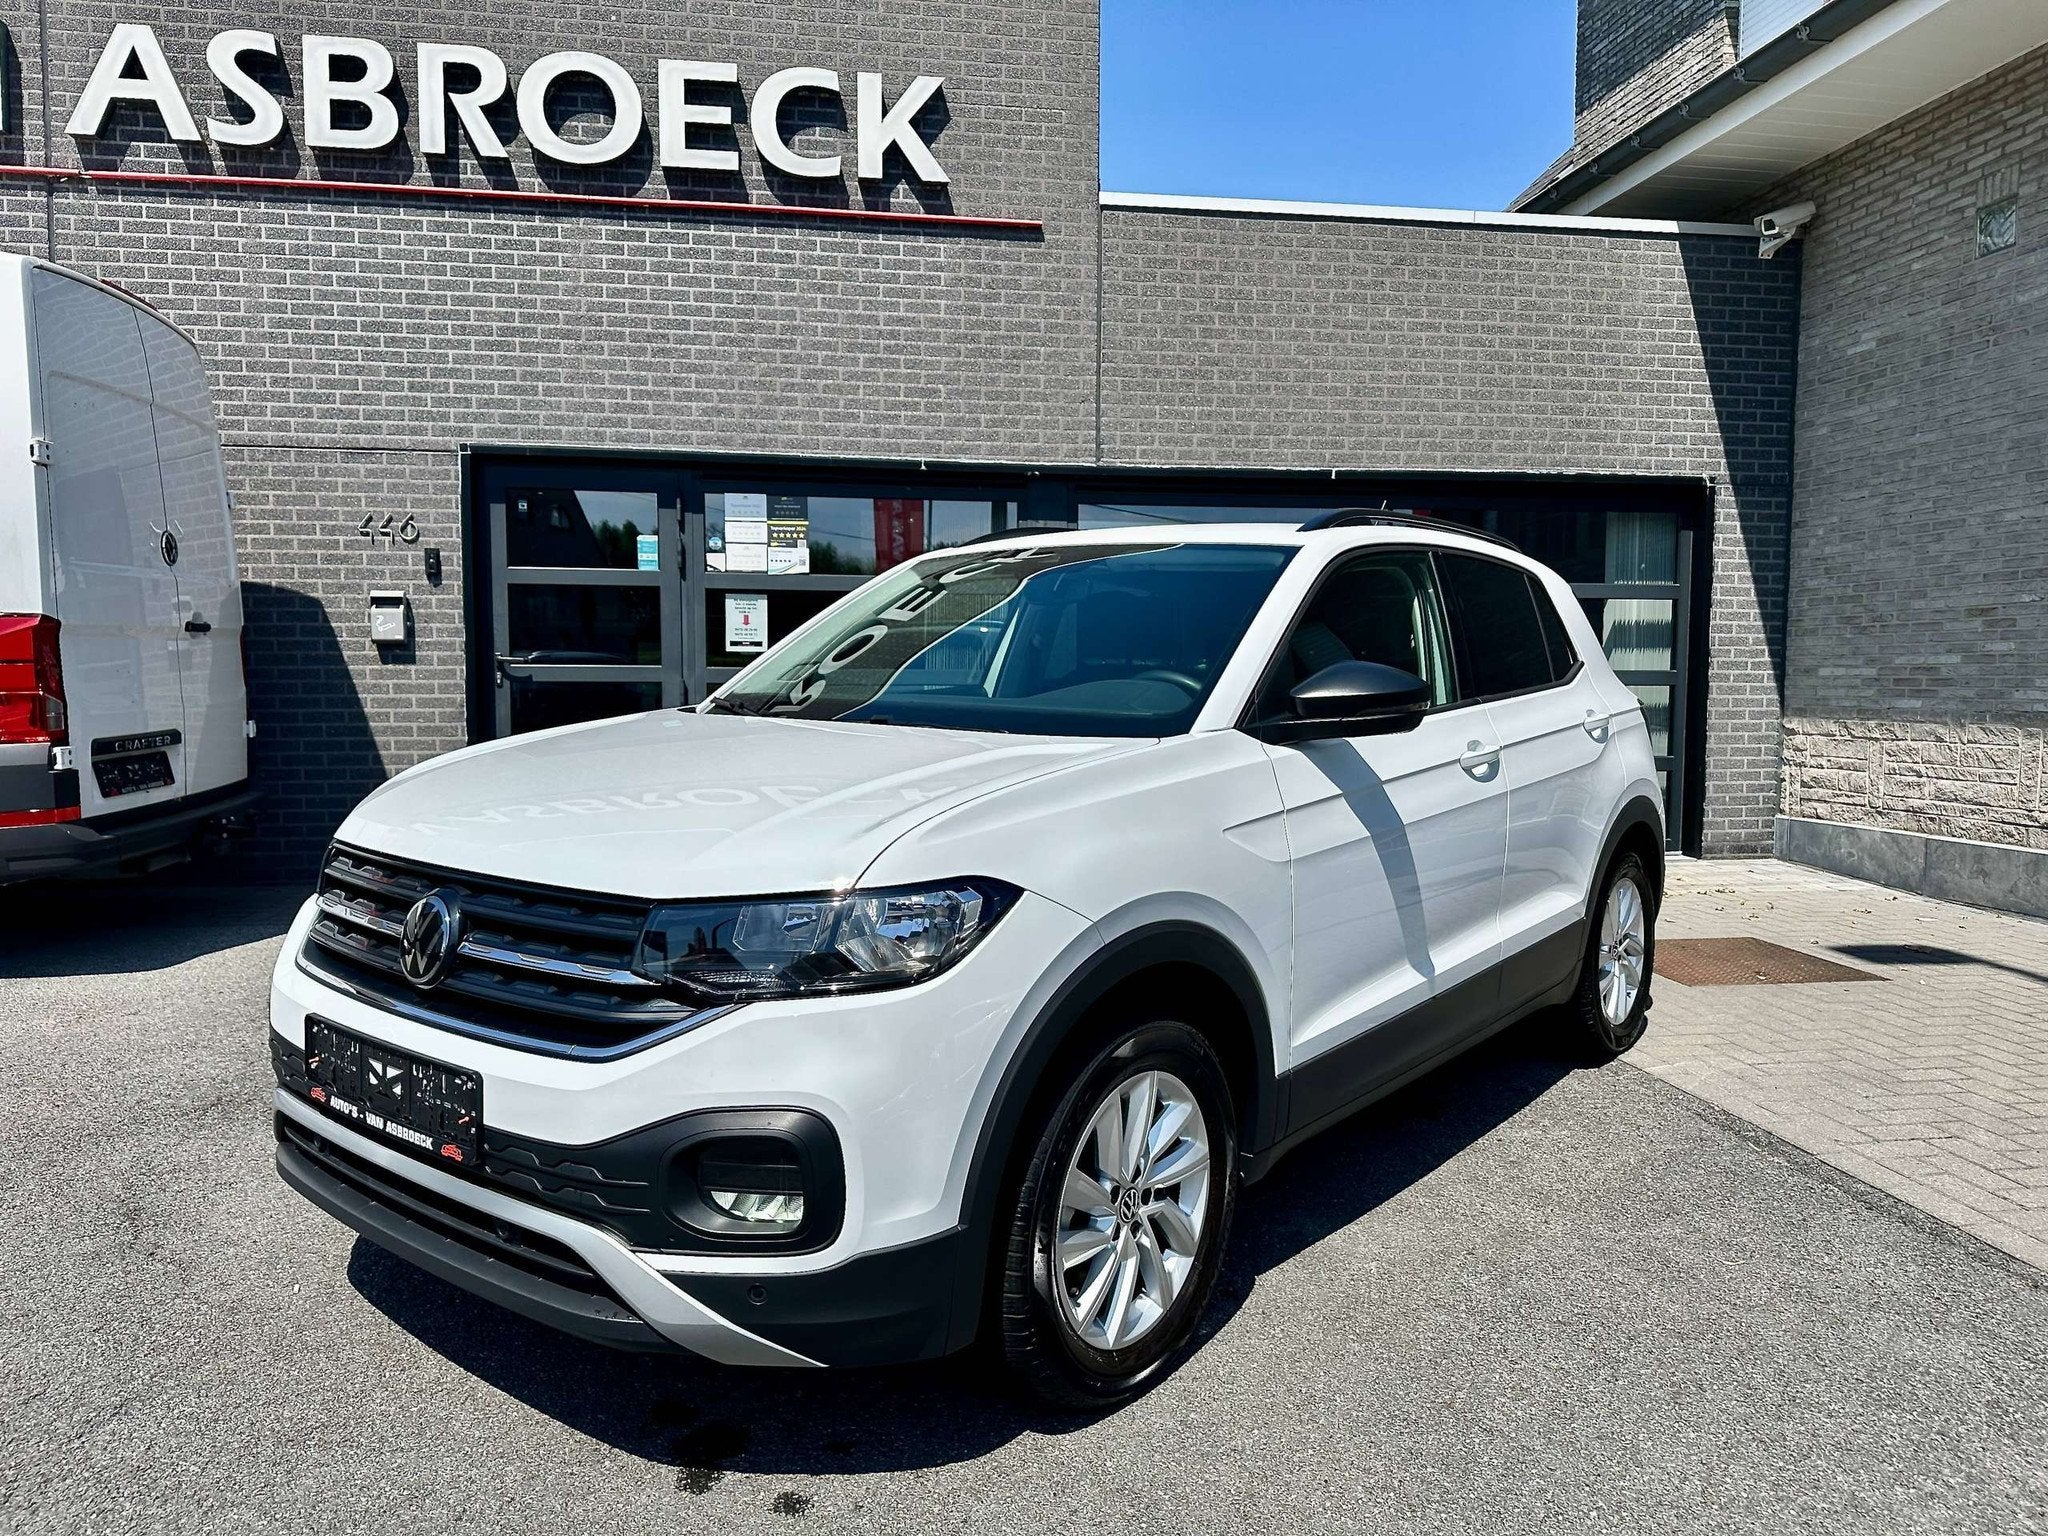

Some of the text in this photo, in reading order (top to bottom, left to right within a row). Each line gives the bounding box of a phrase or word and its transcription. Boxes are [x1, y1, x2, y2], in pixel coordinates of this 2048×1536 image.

[64, 23, 951, 183] ASBROECK
[358, 513, 418, 541] 446
[115, 736, 171, 751] CRAFTER
[330, 1095, 358, 1118] AUTO'S
[366, 1111, 384, 1130] VAN
[386, 1121, 434, 1150] ASBROECK
